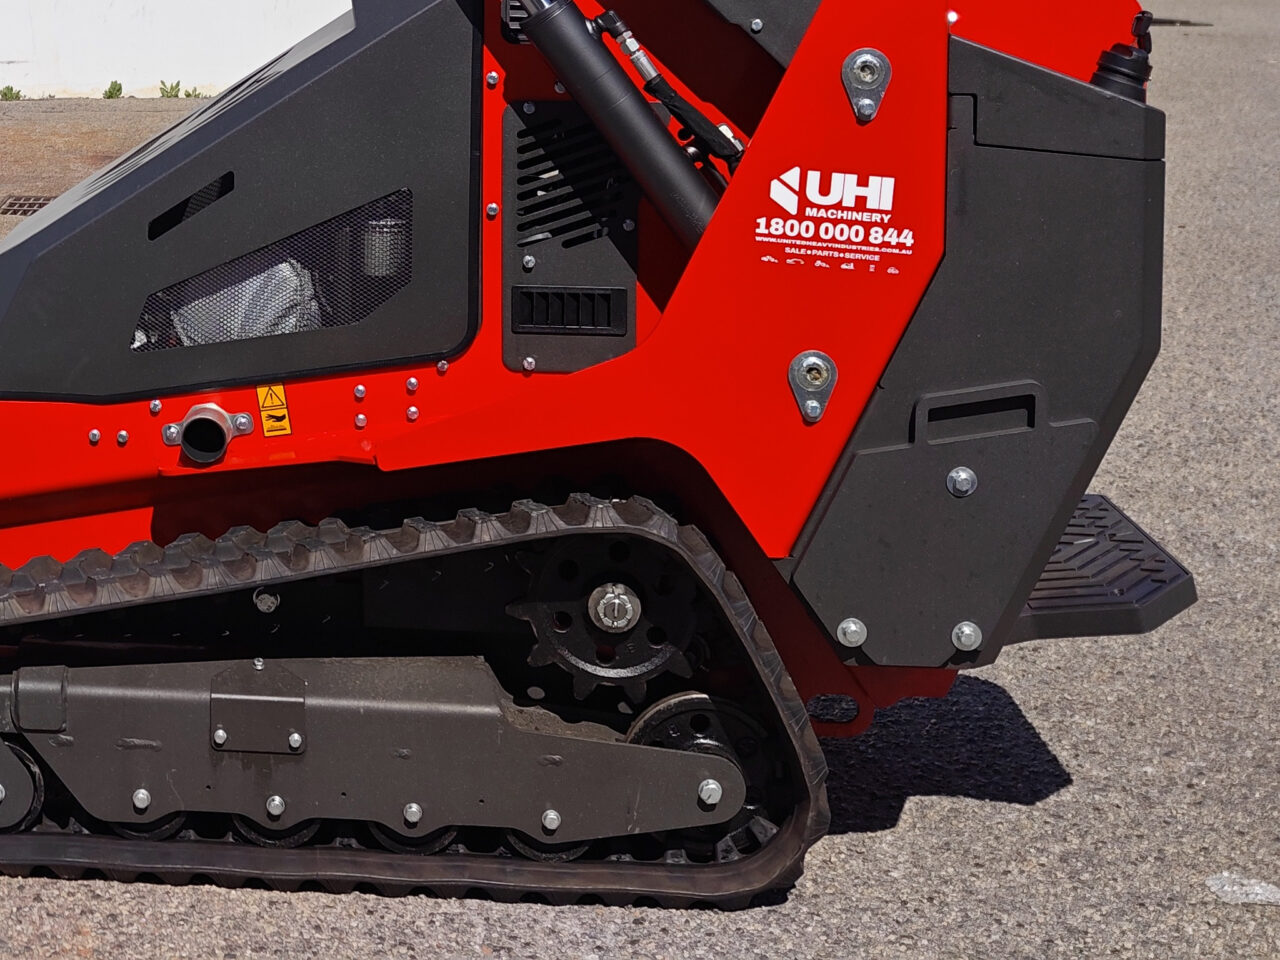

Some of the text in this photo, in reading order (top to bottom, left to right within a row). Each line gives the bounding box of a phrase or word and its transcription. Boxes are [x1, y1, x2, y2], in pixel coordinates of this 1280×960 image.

[806, 170, 895, 211] UHI
[805, 207, 891, 223] MACHINERY
[755, 217, 914, 246] 1800 000 844
[755, 236, 912, 255] WWW.UNITEDHEAVYINDUSTRIES.COM.AU
